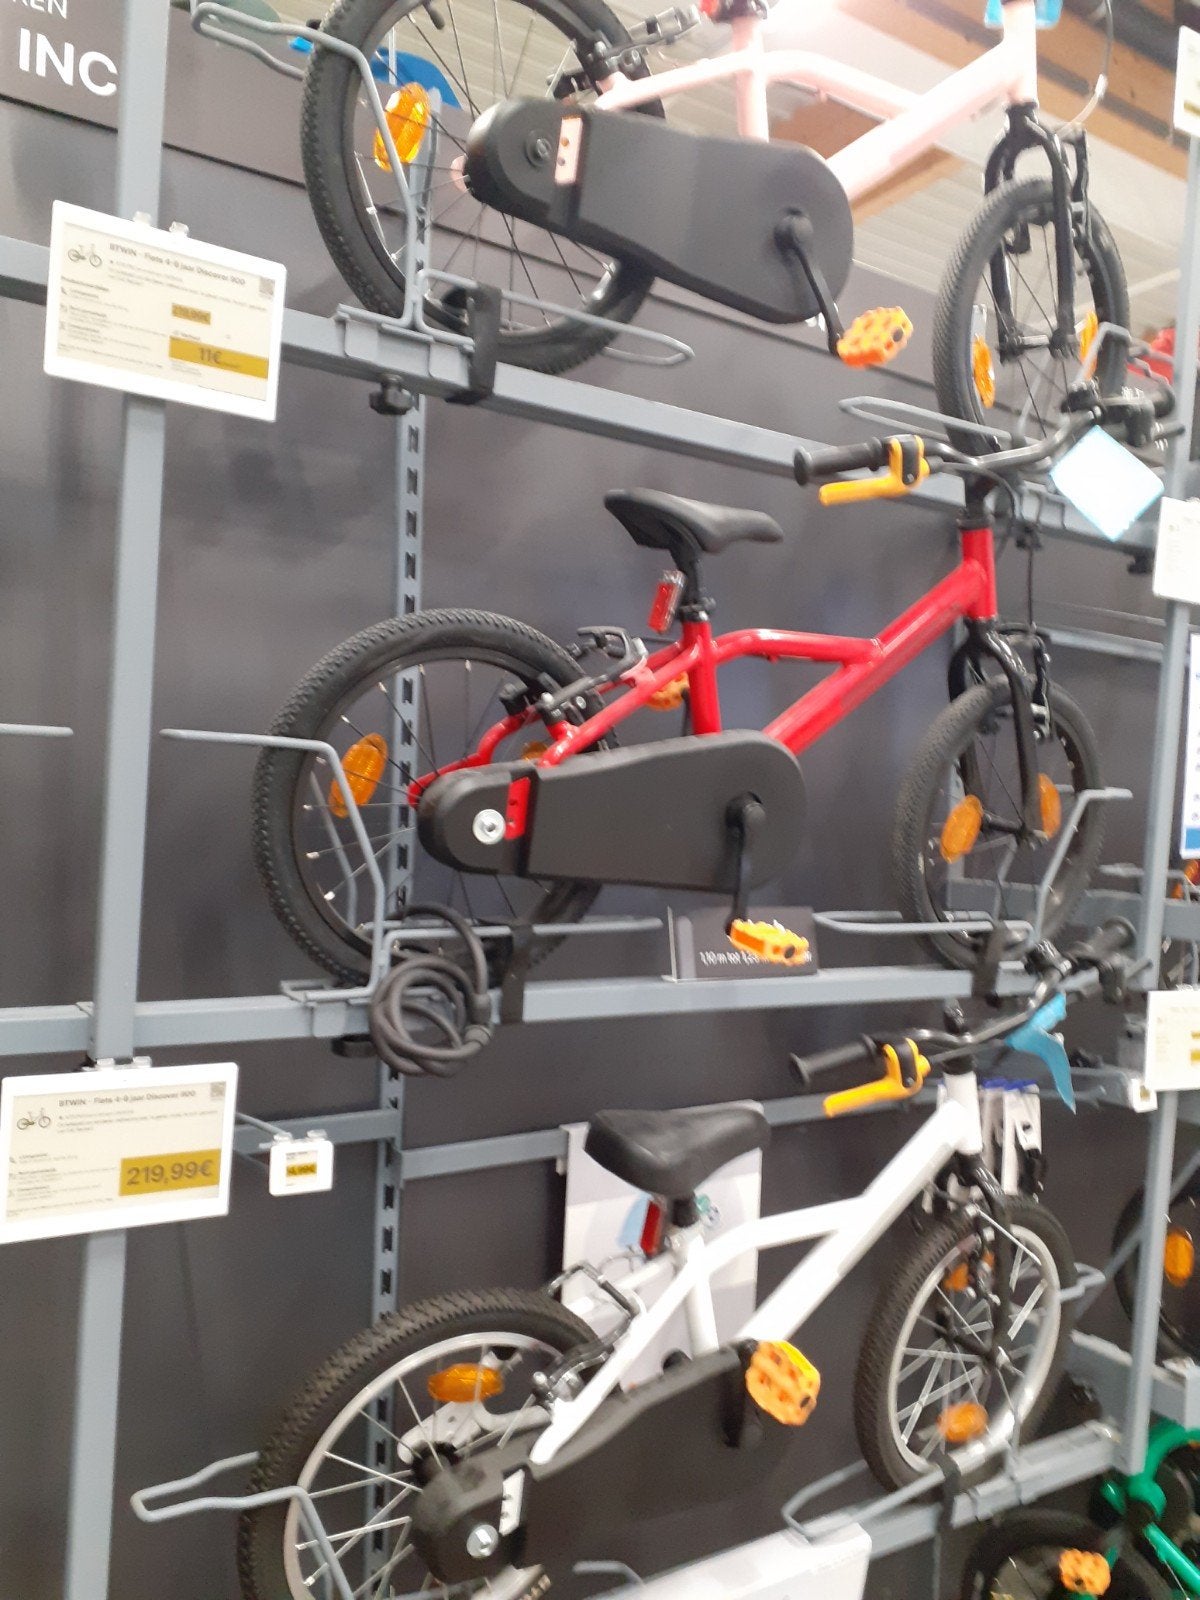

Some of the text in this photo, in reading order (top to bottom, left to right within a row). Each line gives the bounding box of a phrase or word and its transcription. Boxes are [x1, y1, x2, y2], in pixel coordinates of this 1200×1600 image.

[19, 27, 118, 97] INC
[199, 347, 222, 365] 11€
[126, 1159, 214, 1187] 219,99€
